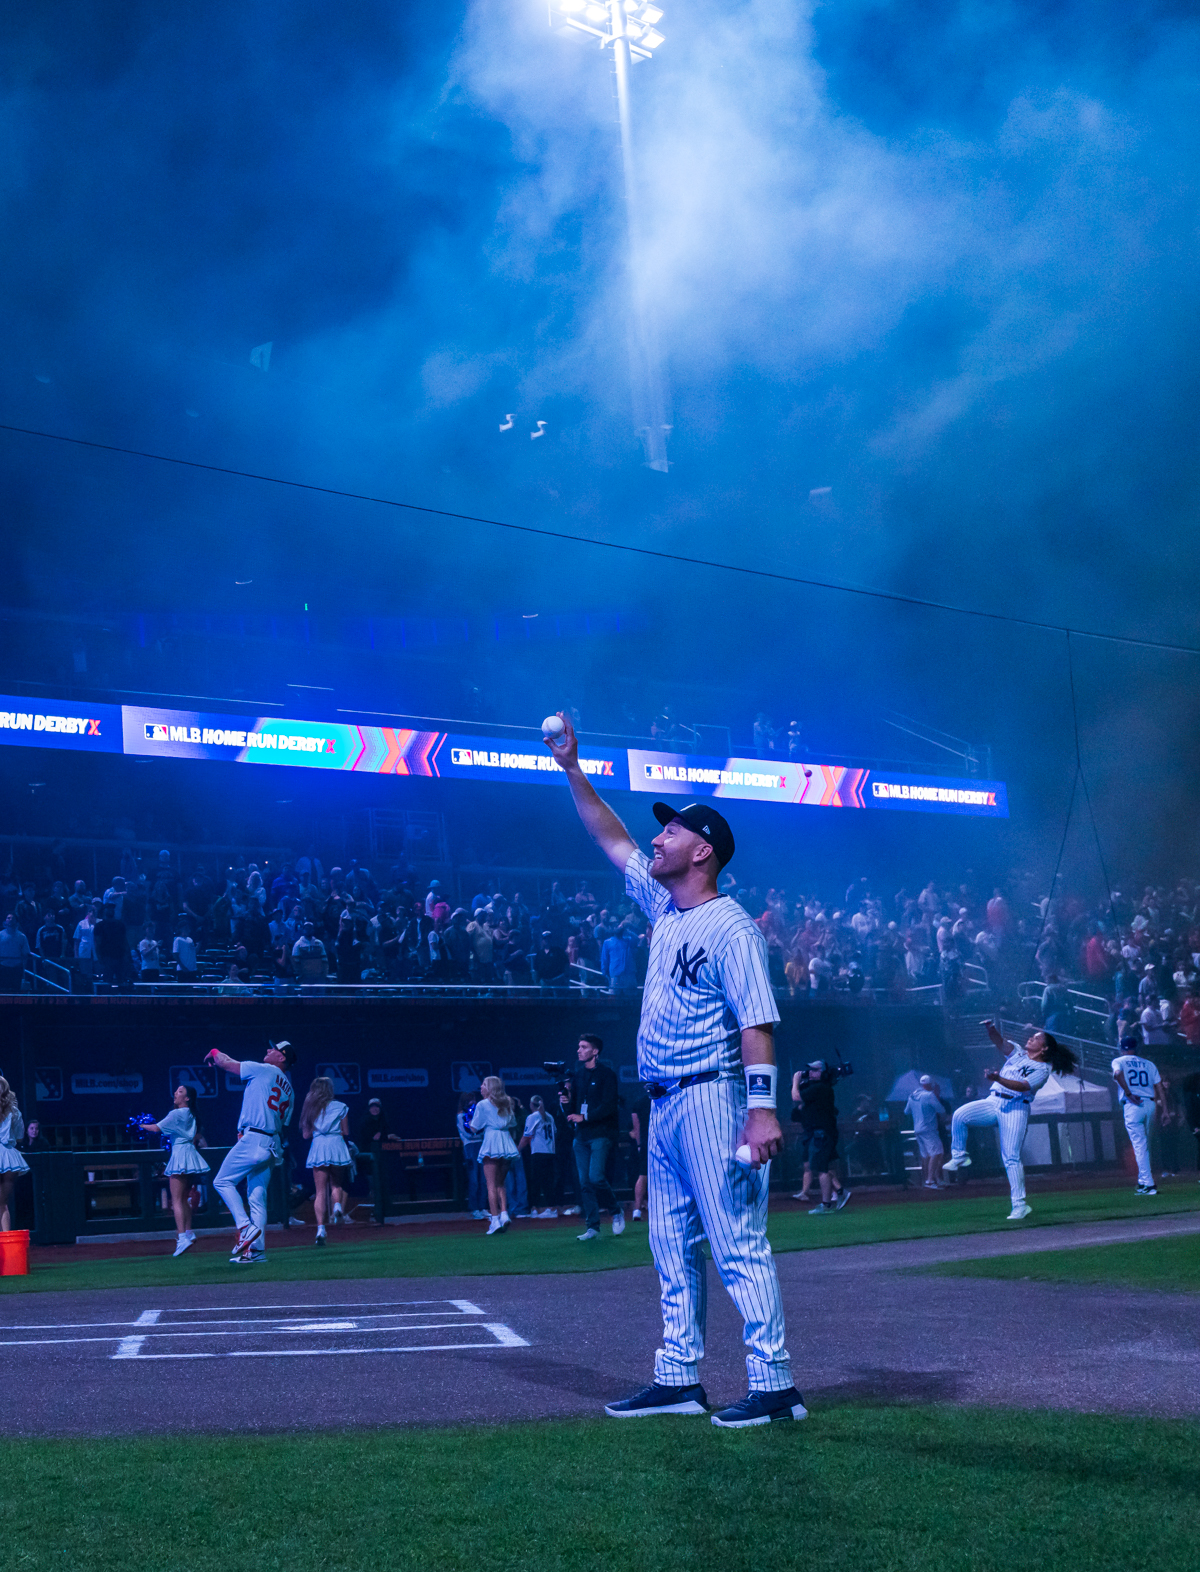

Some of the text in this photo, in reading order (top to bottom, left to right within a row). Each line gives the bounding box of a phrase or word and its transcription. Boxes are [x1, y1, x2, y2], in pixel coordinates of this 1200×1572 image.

[170, 725, 201, 743] MLB
[202, 728, 246, 747] HOME
[247, 731, 277, 749] RUN
[472, 750, 499, 767] MLB
[500, 753, 538, 770] HOME
[664, 766, 687, 781] MLB
[687, 768, 721, 784] HOME
[720, 770, 743, 786] RUN
[889, 784, 909, 799] MLB
[909, 786, 939, 801] HOME
[938, 788, 958, 803] RUN
[670, 942, 708, 988] NY
[1127, 1069, 1149, 1087] 20
[267, 1087, 290, 1120] 24
